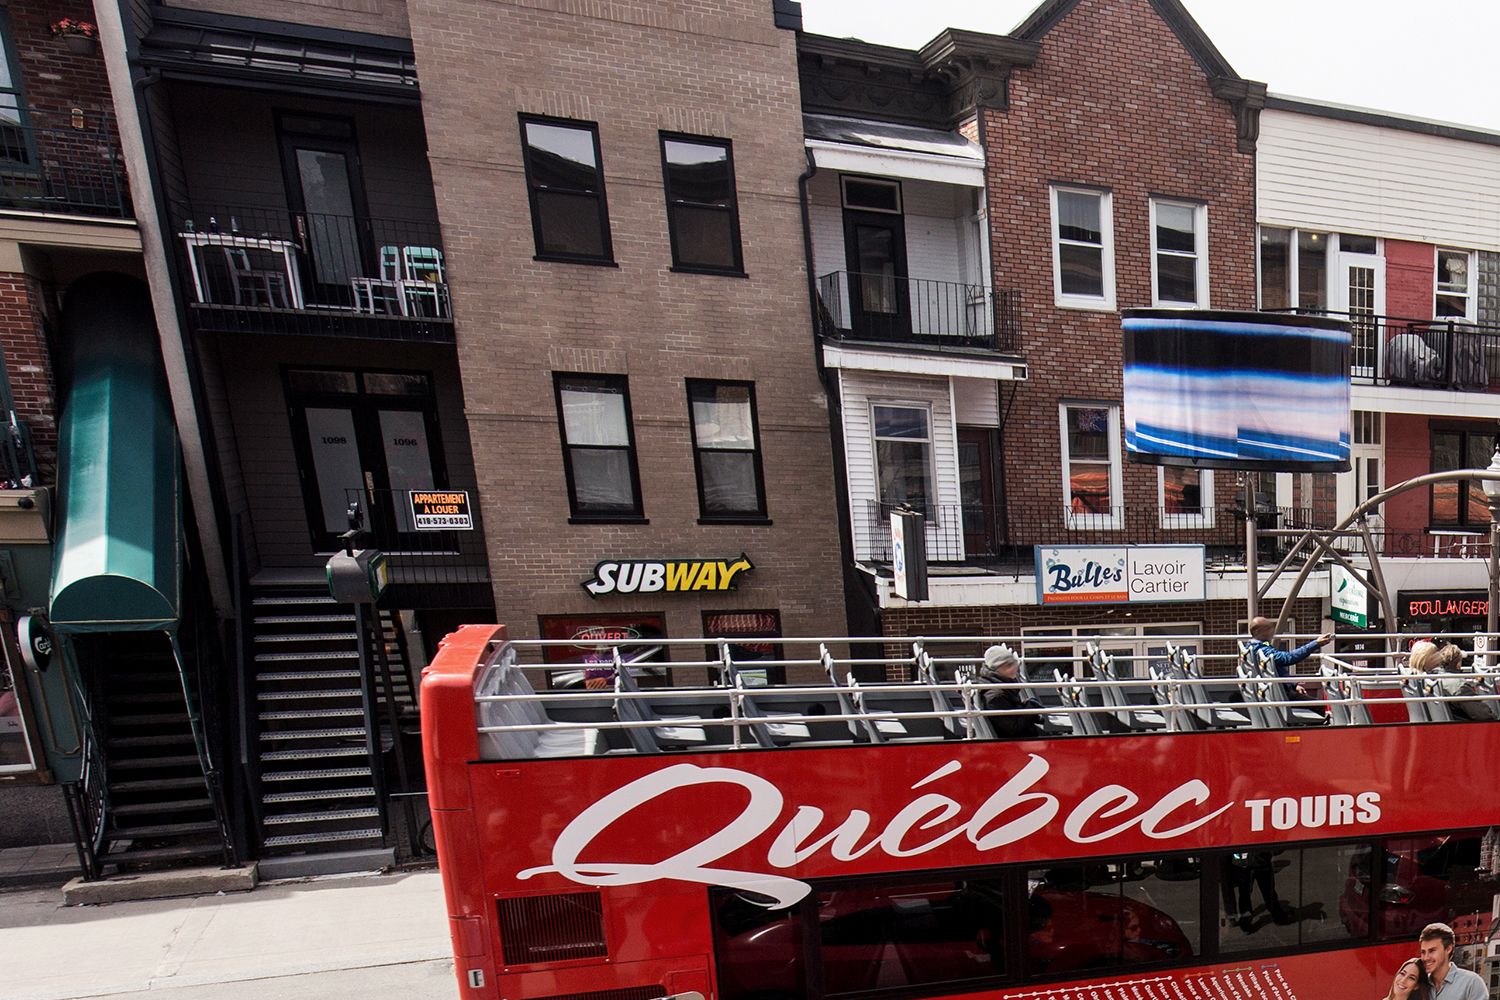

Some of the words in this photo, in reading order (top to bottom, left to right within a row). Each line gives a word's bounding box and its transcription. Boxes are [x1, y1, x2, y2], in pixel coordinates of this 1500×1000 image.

[321, 436, 347, 445] 1098
[393, 438, 418, 446] 1096
[414, 493, 465, 505] APPARTEMENT
[424, 504, 431, 514] À
[432, 505, 459, 514] LOUER
[1133, 560, 1186, 576] Lavoir
[586, 559, 752, 596] SUBWAY
[1048, 561, 1123, 592] Bulles
[1130, 578, 1189, 594] Cartier
[1409, 600, 1489, 616] BOULANGERI
[515, 753, 1234, 911] Québec
[1245, 791, 1382, 833] TOURS
